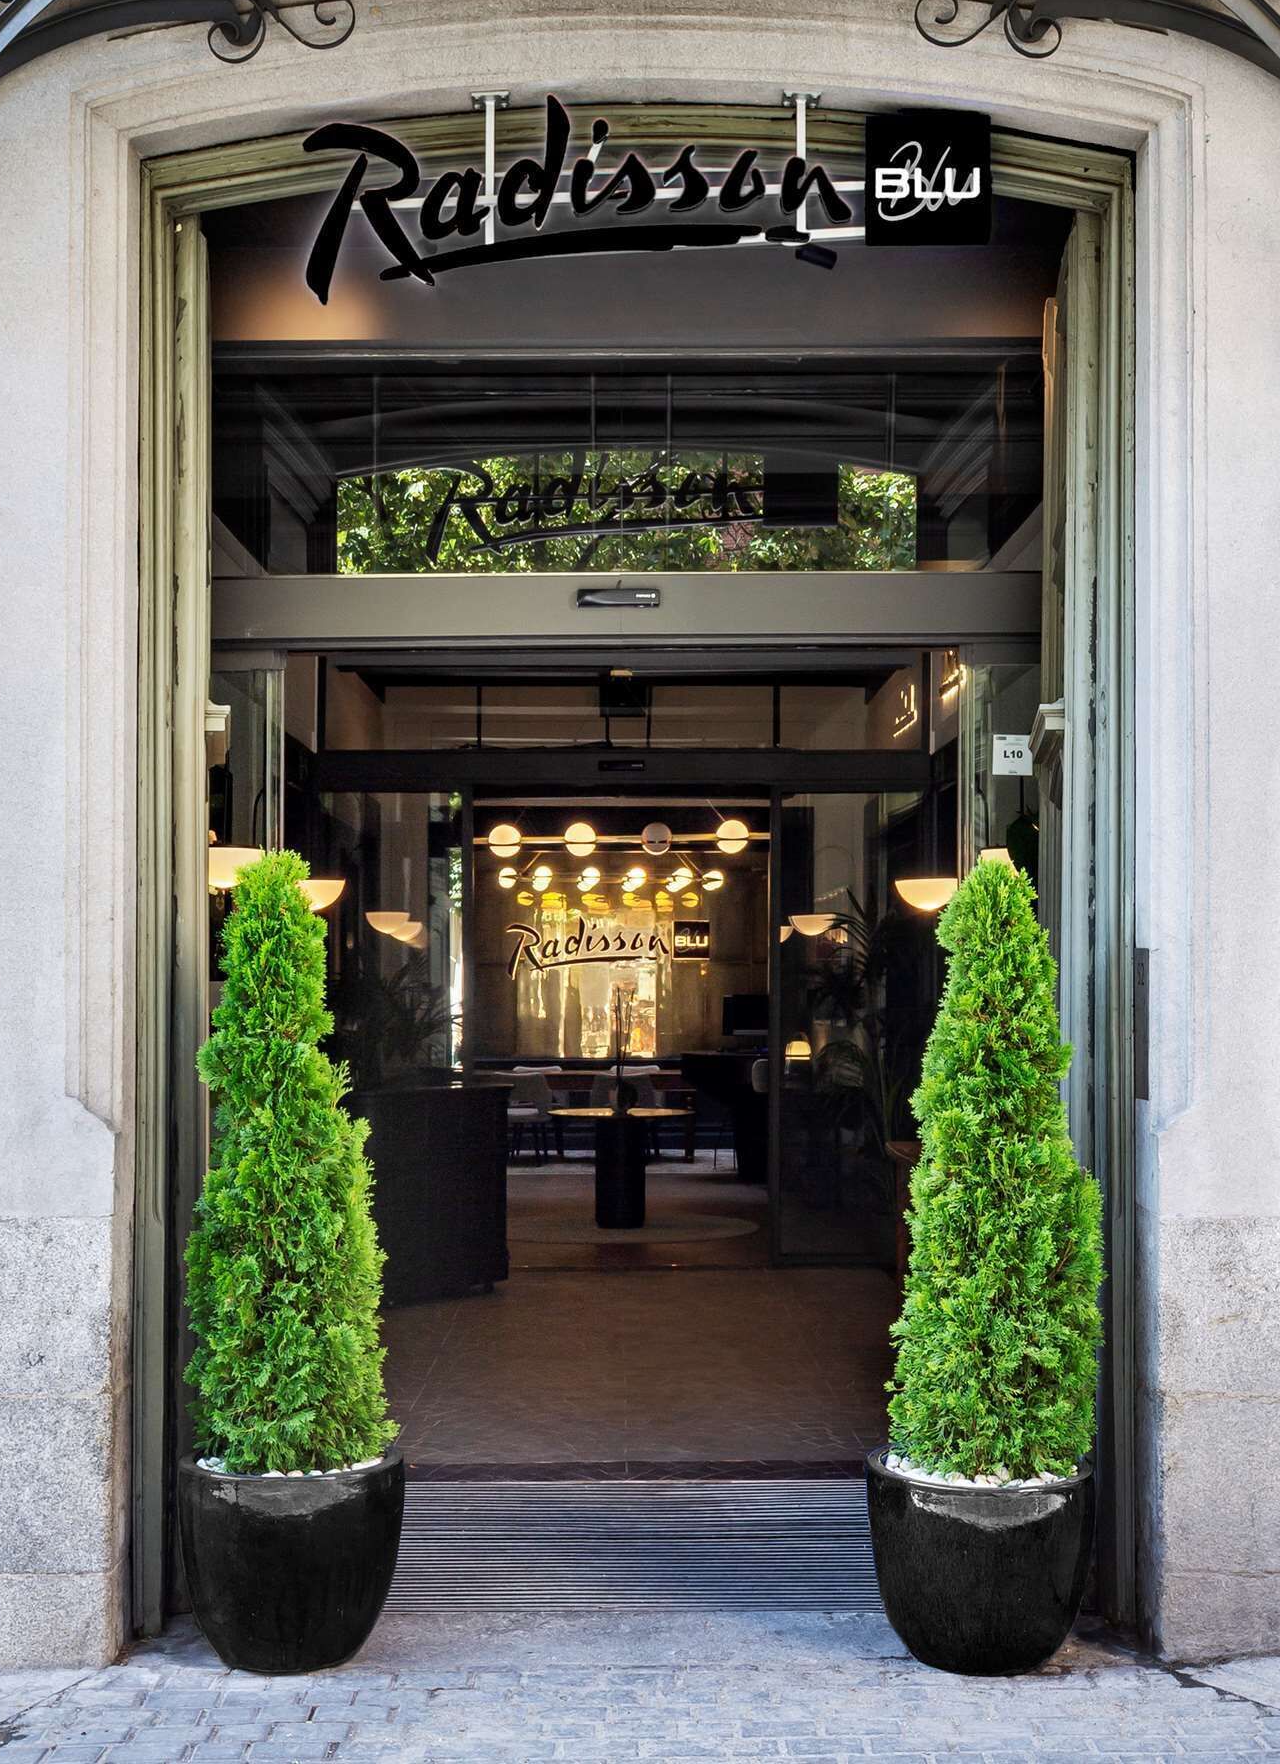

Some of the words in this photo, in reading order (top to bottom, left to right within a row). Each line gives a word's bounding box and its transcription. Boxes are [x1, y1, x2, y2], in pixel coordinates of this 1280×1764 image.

[302, 94, 852, 306] Radisson
[1003, 749, 1023, 759] L10
[506, 916, 670, 980] Radisson
